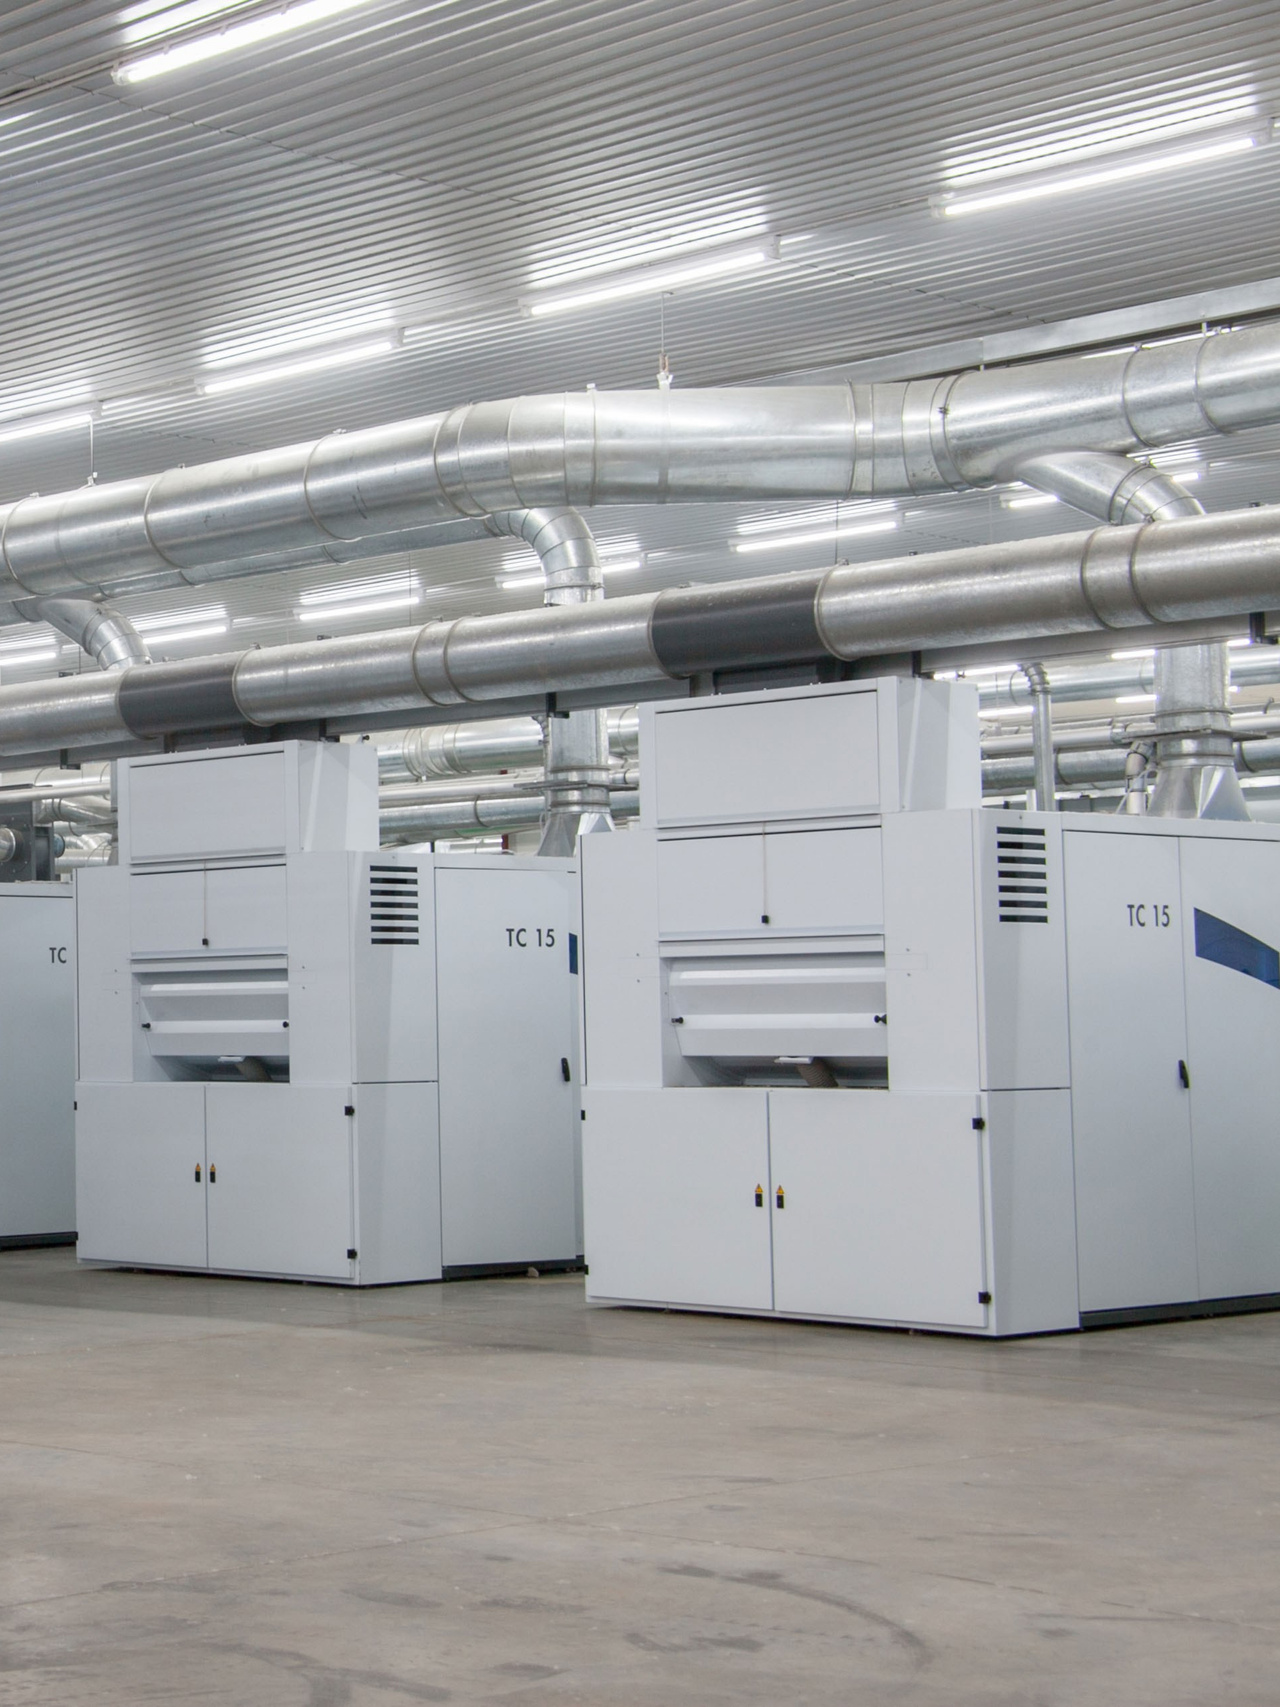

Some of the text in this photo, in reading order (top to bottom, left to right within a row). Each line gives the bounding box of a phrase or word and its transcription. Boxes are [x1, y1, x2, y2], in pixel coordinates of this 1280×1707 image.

[1127, 904, 1170, 927] TC 15
[506, 928, 555, 947] TC 15
[49, 946, 67, 964] TC
